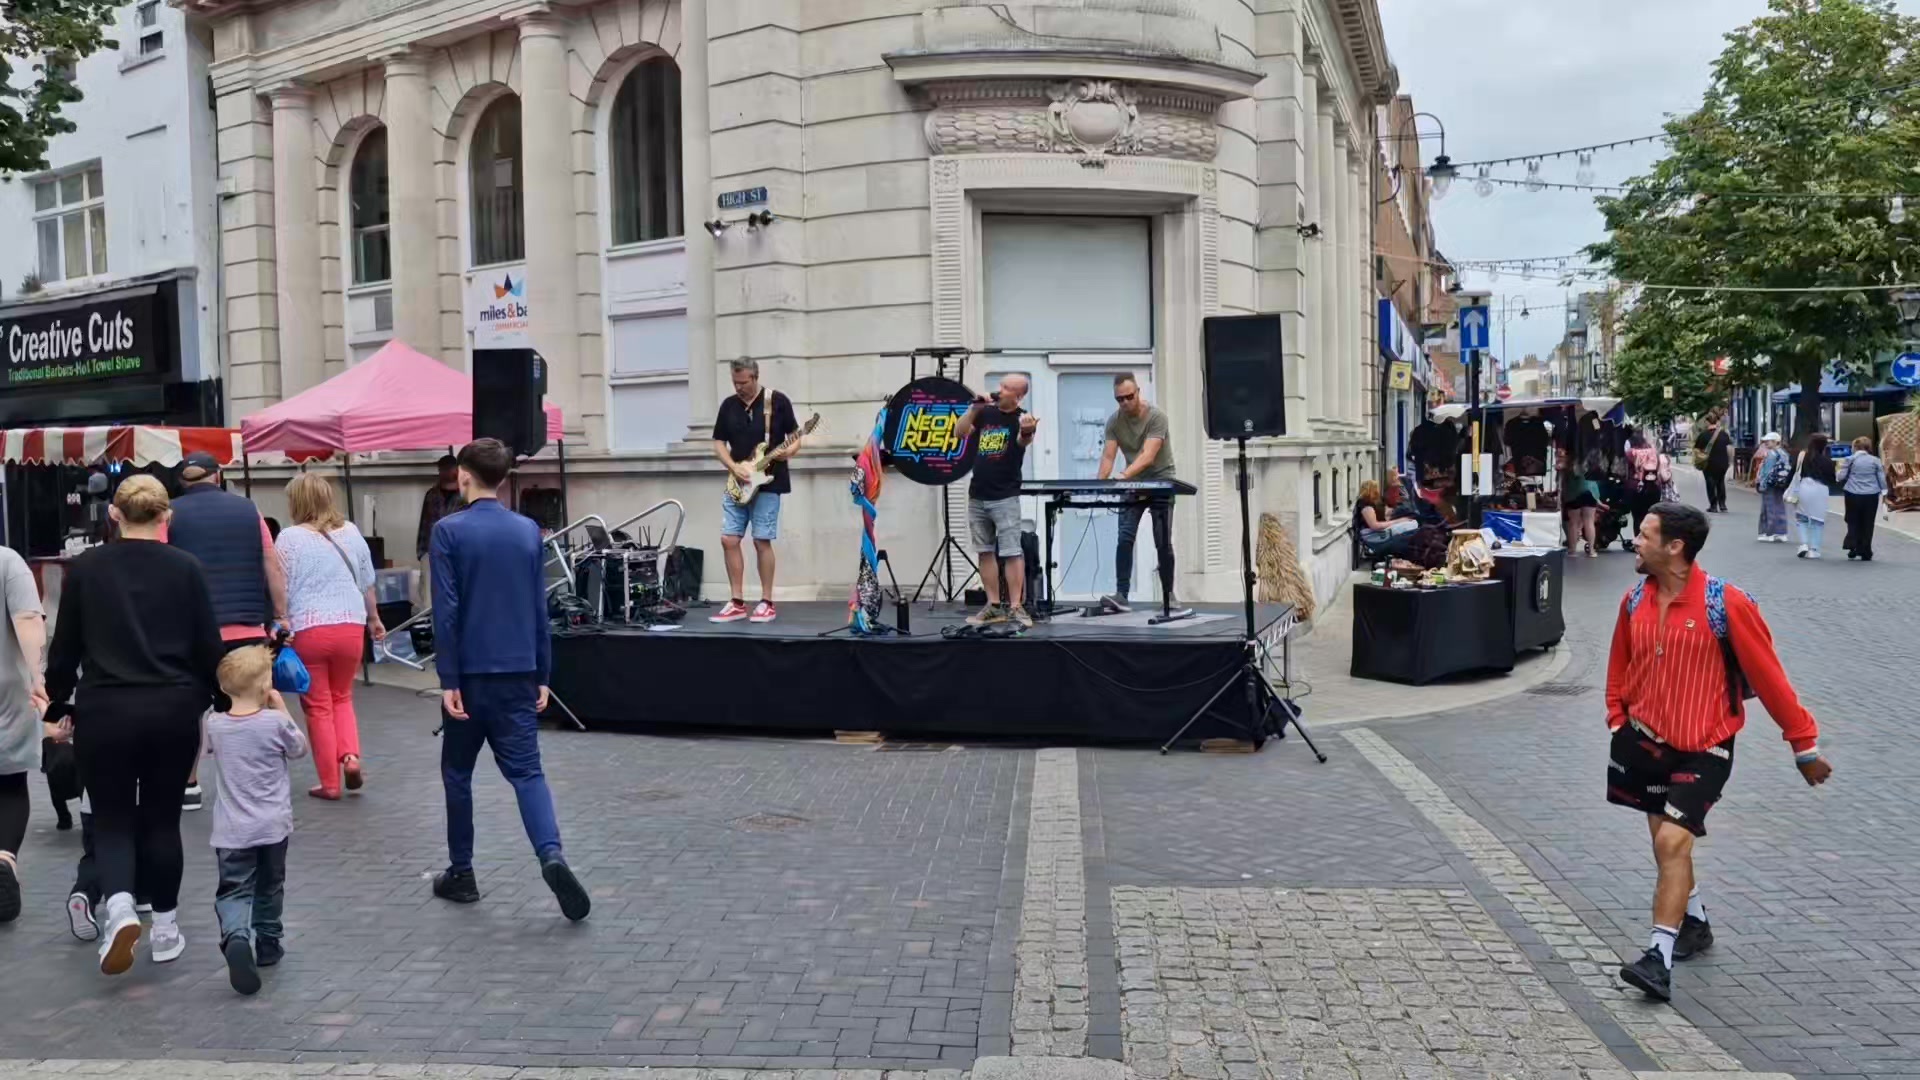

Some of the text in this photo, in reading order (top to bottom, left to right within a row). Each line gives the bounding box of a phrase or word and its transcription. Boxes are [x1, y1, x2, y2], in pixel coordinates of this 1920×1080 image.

[722, 188, 762, 207] HIGH ST
[9, 309, 134, 363] Creative Cuts
[8, 365, 45, 382] Traditional
[92, 357, 115, 374] Towel
[115, 354, 141, 370] Shave
[900, 430, 960, 453] RUSH
